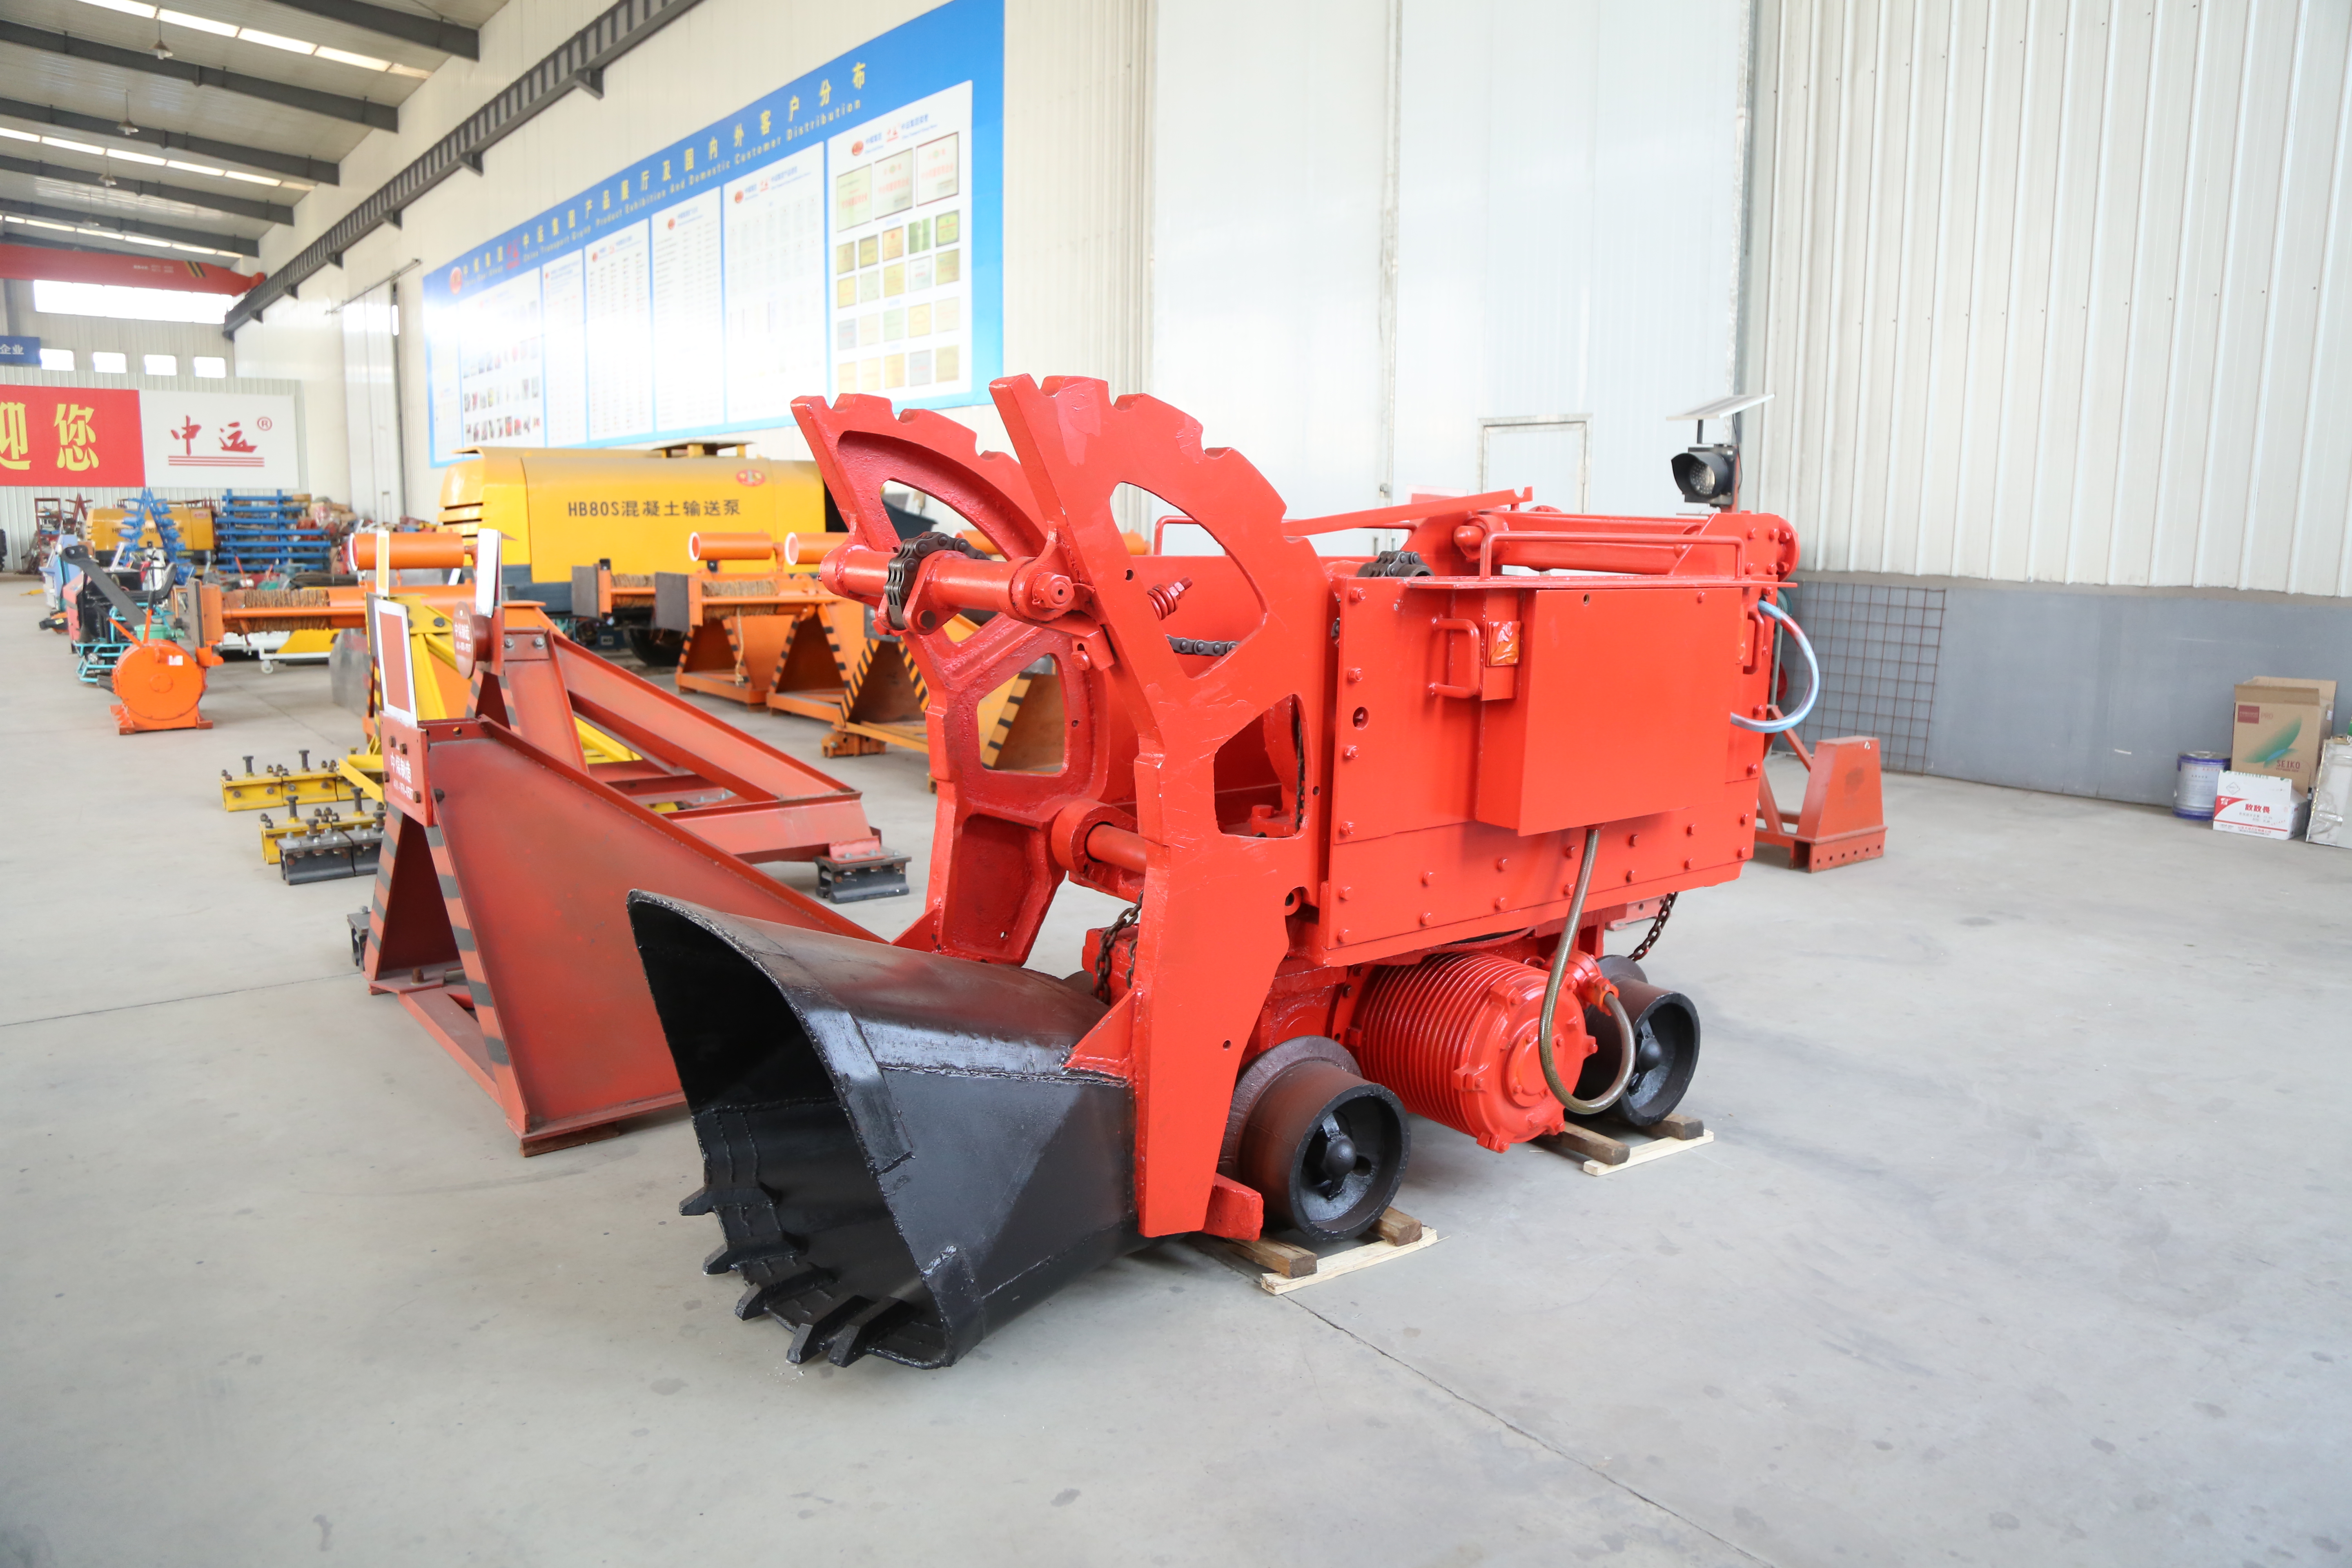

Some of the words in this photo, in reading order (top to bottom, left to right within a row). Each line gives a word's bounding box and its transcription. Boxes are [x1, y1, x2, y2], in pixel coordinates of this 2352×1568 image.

[596, 209, 622, 227] Product
[625, 189, 666, 214] Exhibition
[670, 178, 685, 193] And
[689, 160, 730, 185] Domestic
[735, 137, 781, 165] Customer
[787, 99, 860, 141] Distribution
[0, 344, 24, 354] 企业
[171, 415, 258, 457] 中运
[2277, 760, 2300, 769] SEIKO
